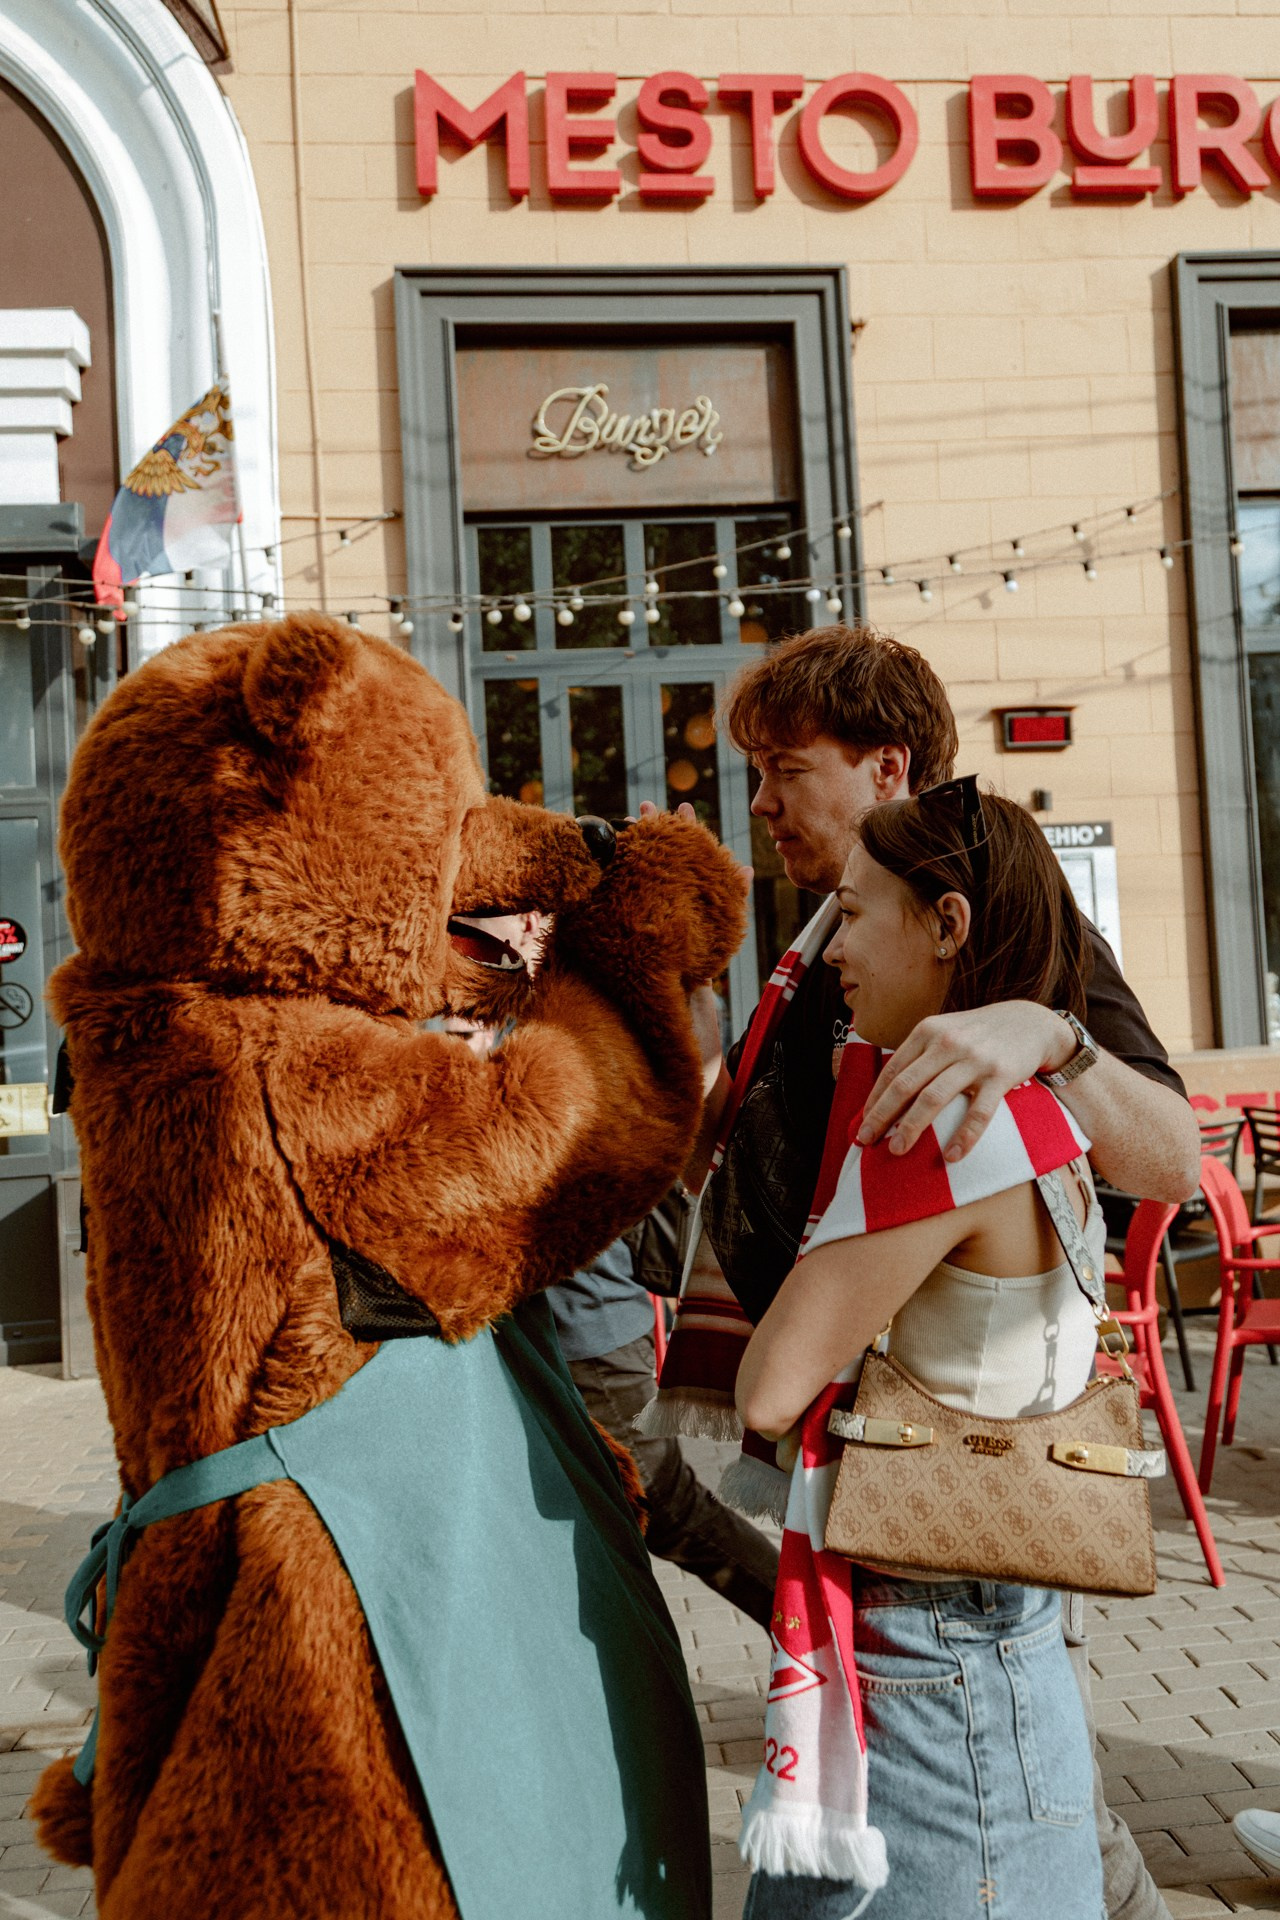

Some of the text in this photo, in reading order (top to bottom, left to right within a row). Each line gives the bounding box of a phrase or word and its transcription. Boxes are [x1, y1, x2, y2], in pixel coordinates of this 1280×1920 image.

[414, 69, 1280, 198] MESTO BUR
[533, 383, 723, 466] Burger
[1043, 825, 1095, 848] ЕНЮ
[963, 1435, 1014, 1451] GUESS
[763, 1737, 798, 1781] 22
